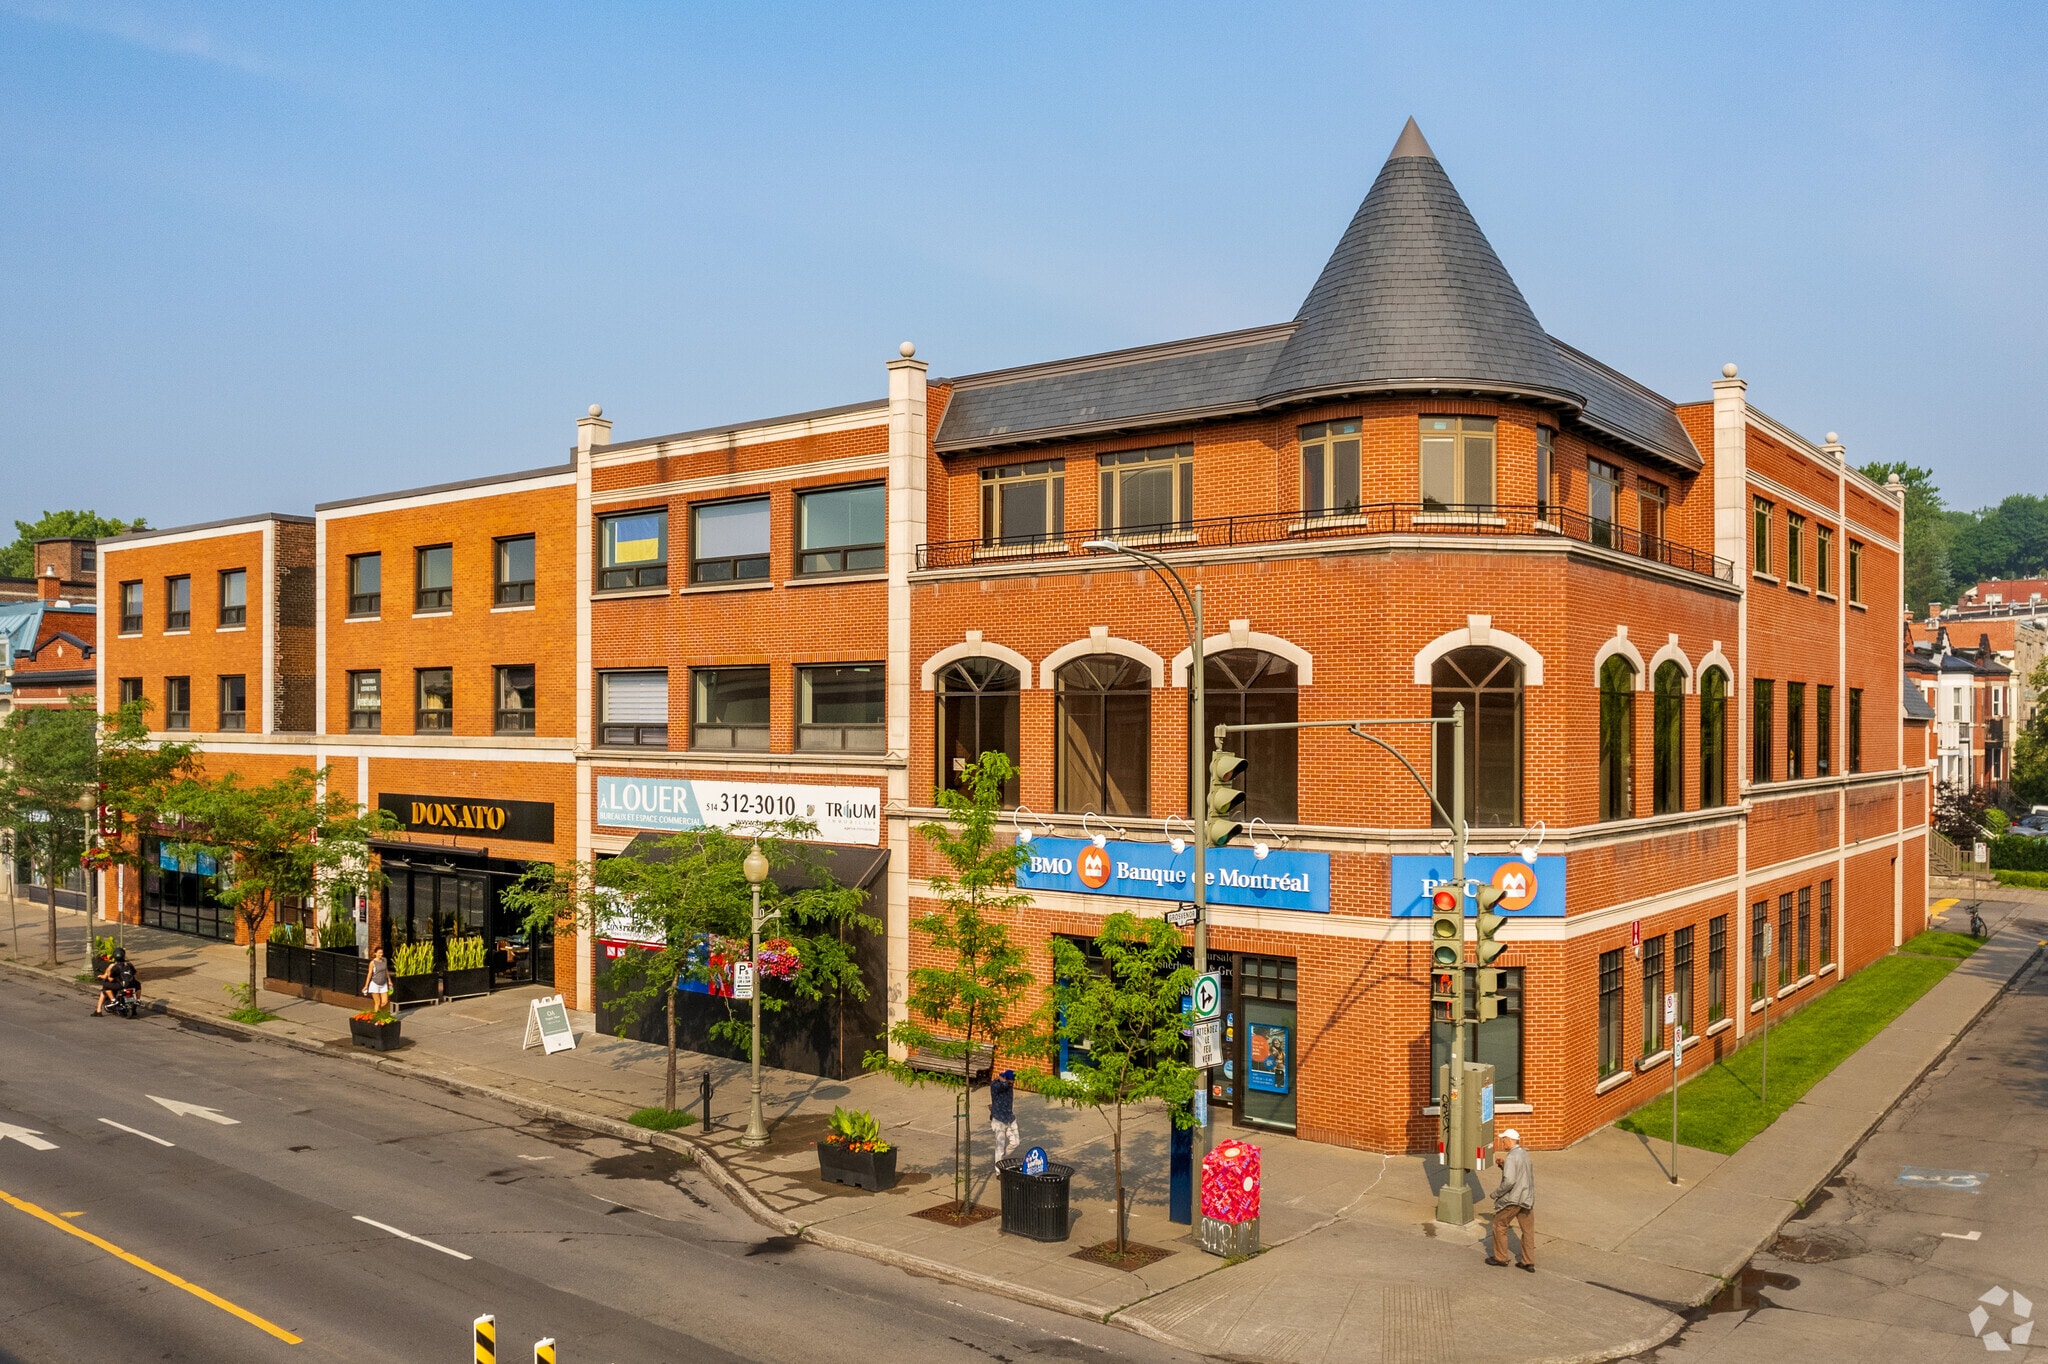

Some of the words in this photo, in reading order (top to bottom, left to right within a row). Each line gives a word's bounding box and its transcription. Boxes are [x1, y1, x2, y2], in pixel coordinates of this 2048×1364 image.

[600, 793, 608, 809] À
[610, 783, 689, 814] LOUER
[706, 802, 718, 812] 514
[720, 792, 796, 816] 312-3010
[411, 801, 505, 831] DONATO
[600, 812, 627, 821] BUREAUX
[627, 814, 635, 822] ET
[636, 815, 658, 824] ESPACE
[658, 815, 701, 827] COMMERCIAL
[1030, 856, 1073, 875] BMO
[1117, 861, 1186, 887] Banque
[1218, 868, 1310, 893] Montréal
[1169, 910, 1196, 922] GROSVENOR
[1196, 1024, 1218, 1036] ATTENDEZ
[1204, 1036, 1210, 1045] LE
[1203, 1045, 1212, 1054] FEU
[1202, 1053, 1213, 1063] VERT
